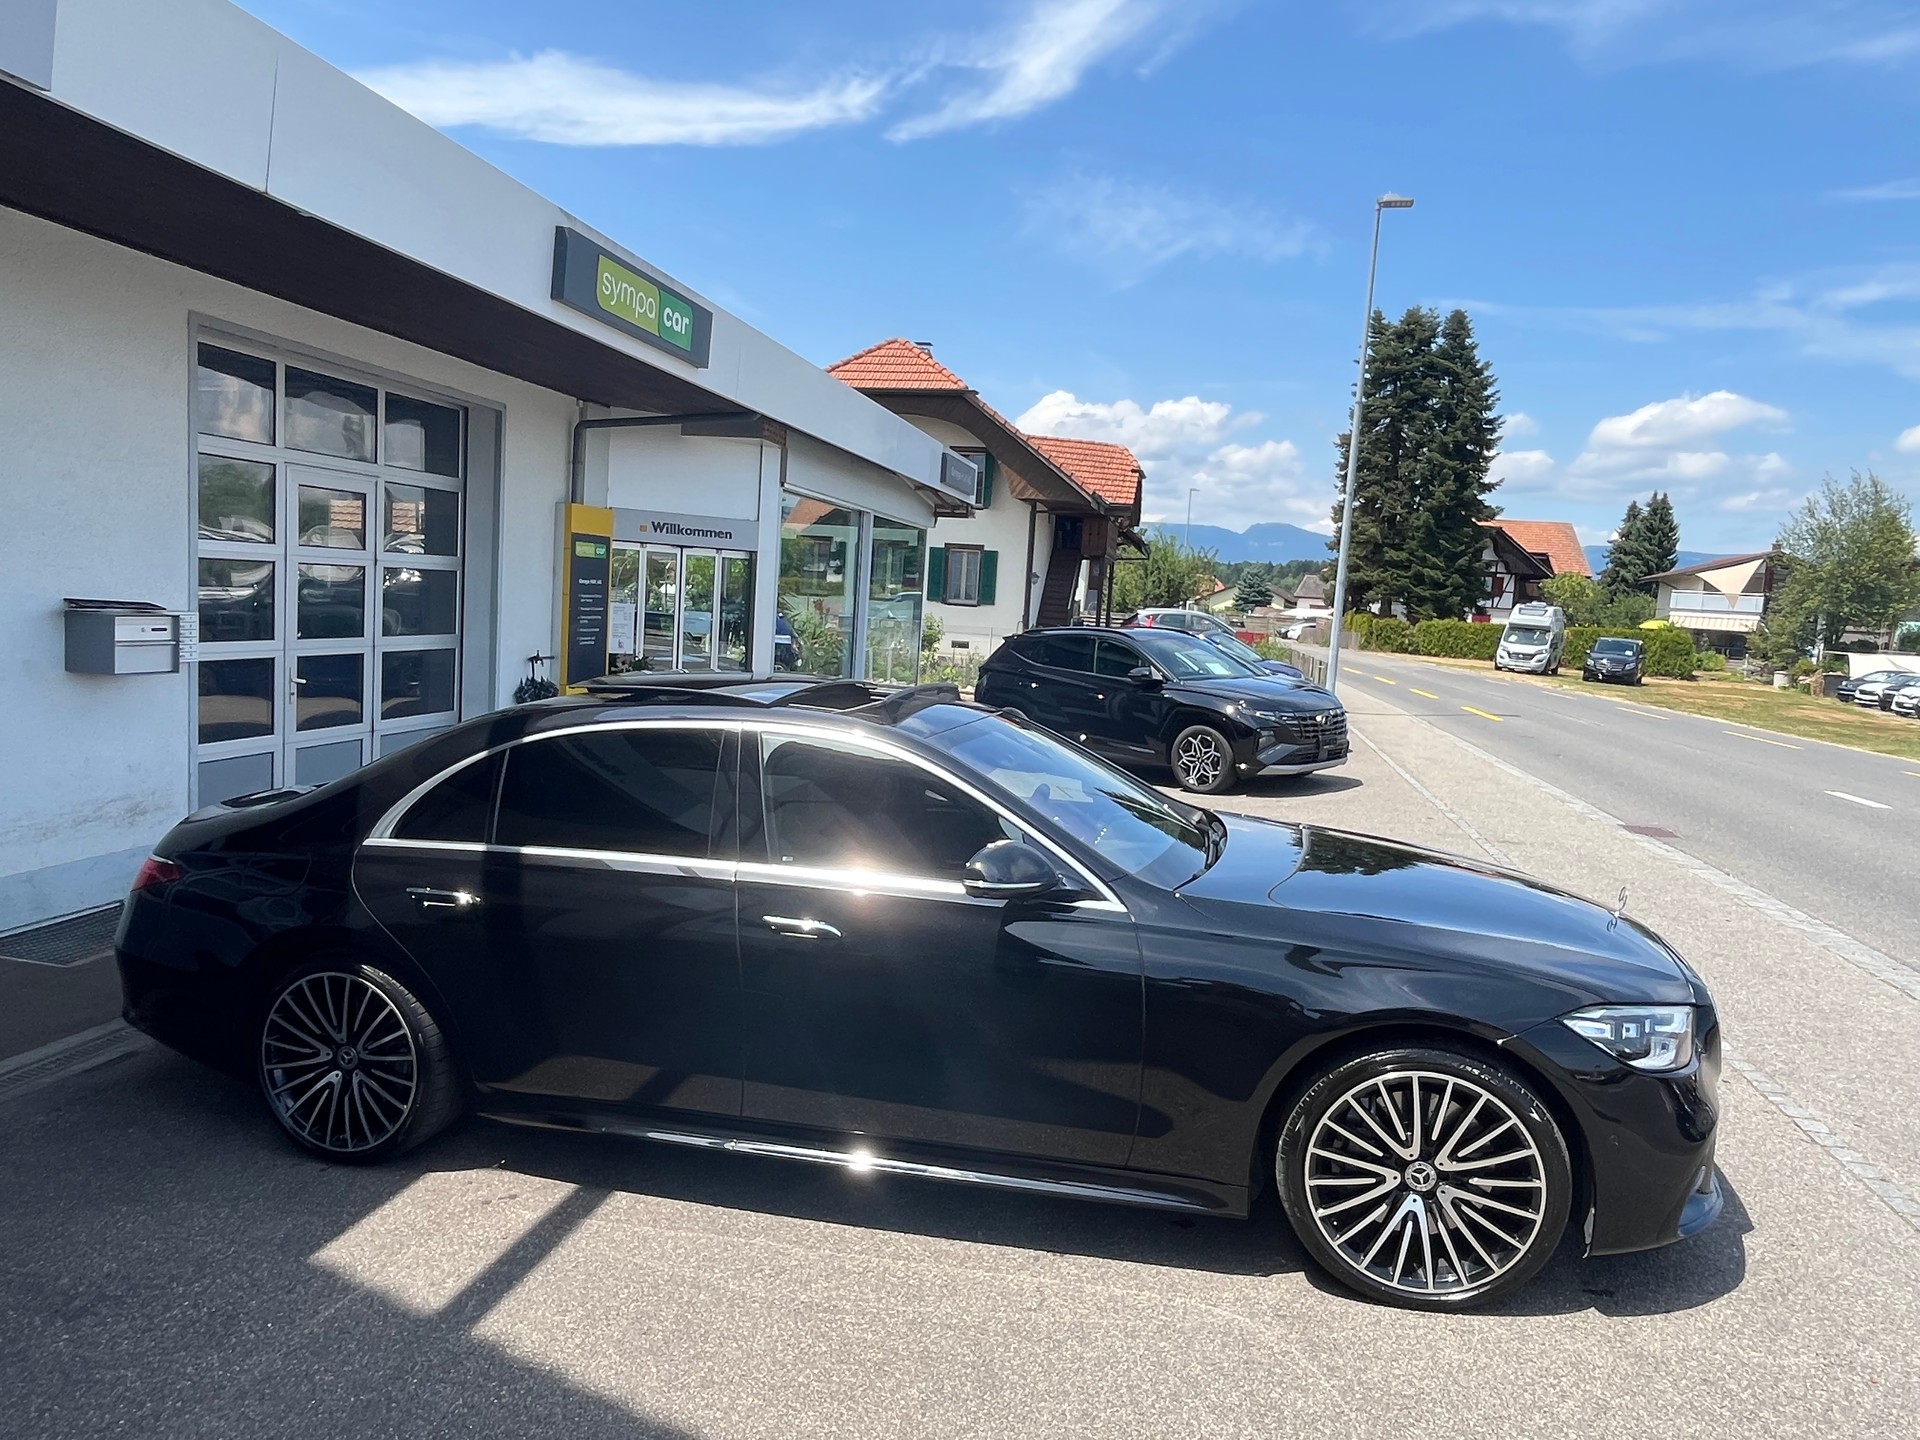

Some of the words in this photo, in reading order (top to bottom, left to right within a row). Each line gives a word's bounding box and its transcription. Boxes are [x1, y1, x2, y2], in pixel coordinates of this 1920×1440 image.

[602, 272, 656, 319] sympa
[663, 307, 690, 335] car
[651, 521, 733, 539] Willkommen
